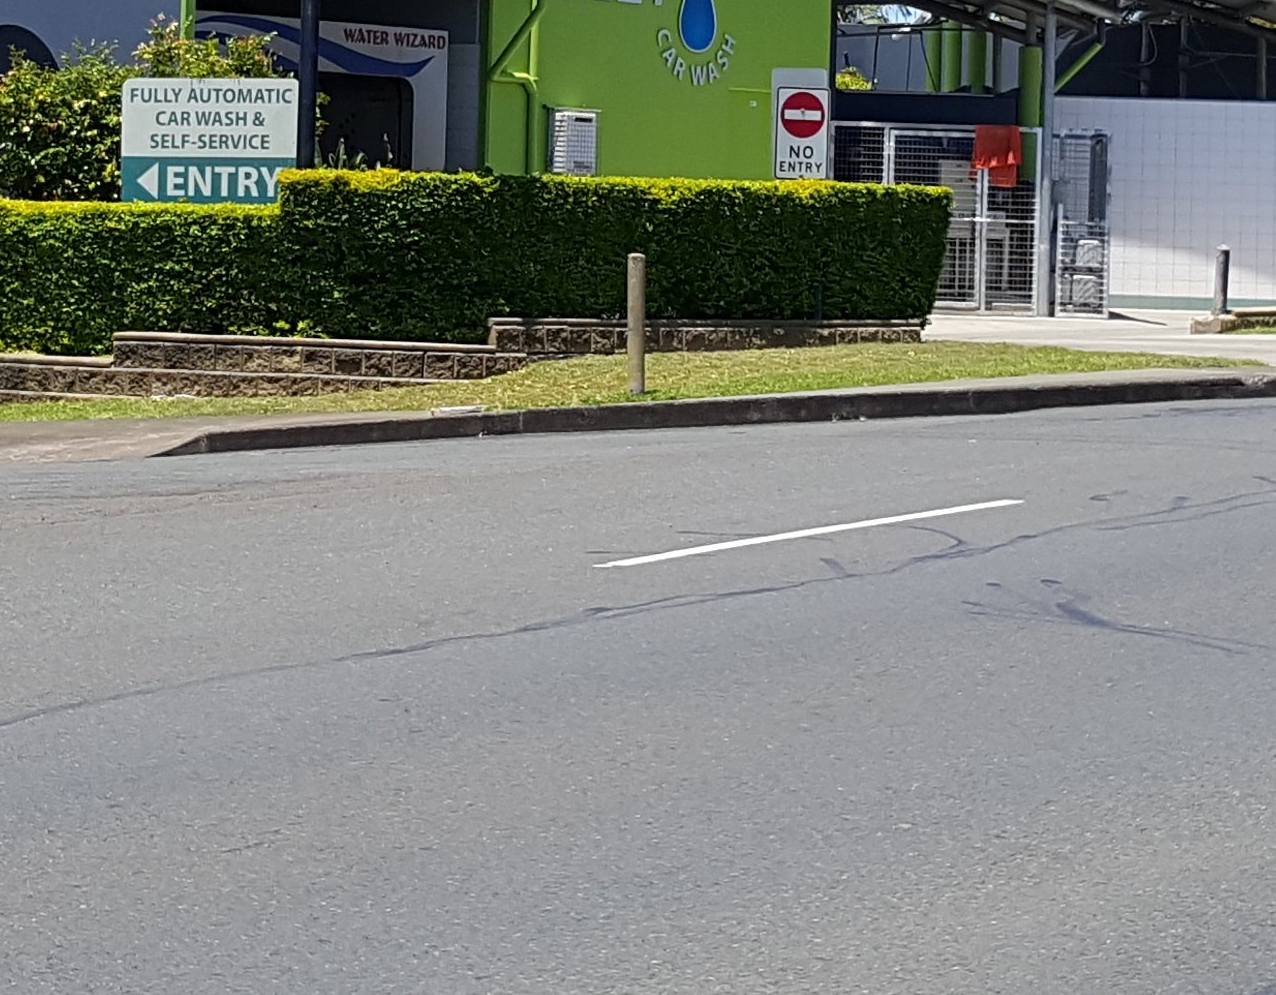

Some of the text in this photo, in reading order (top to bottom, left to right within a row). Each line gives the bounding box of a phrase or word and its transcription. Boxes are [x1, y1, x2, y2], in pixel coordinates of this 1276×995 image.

[344, 28, 446, 49] WATER WIZARD
[657, 29, 736, 86] CAR WASH
[130, 87, 293, 104] FULLY AUTOMATIC
[155, 111, 265, 126] CAR WASH &
[150, 134, 270, 150] SELF-SERVICE
[789, 145, 814, 159] NO
[779, 161, 823, 173] ENTRY
[166, 166, 280, 198] ENTRY
